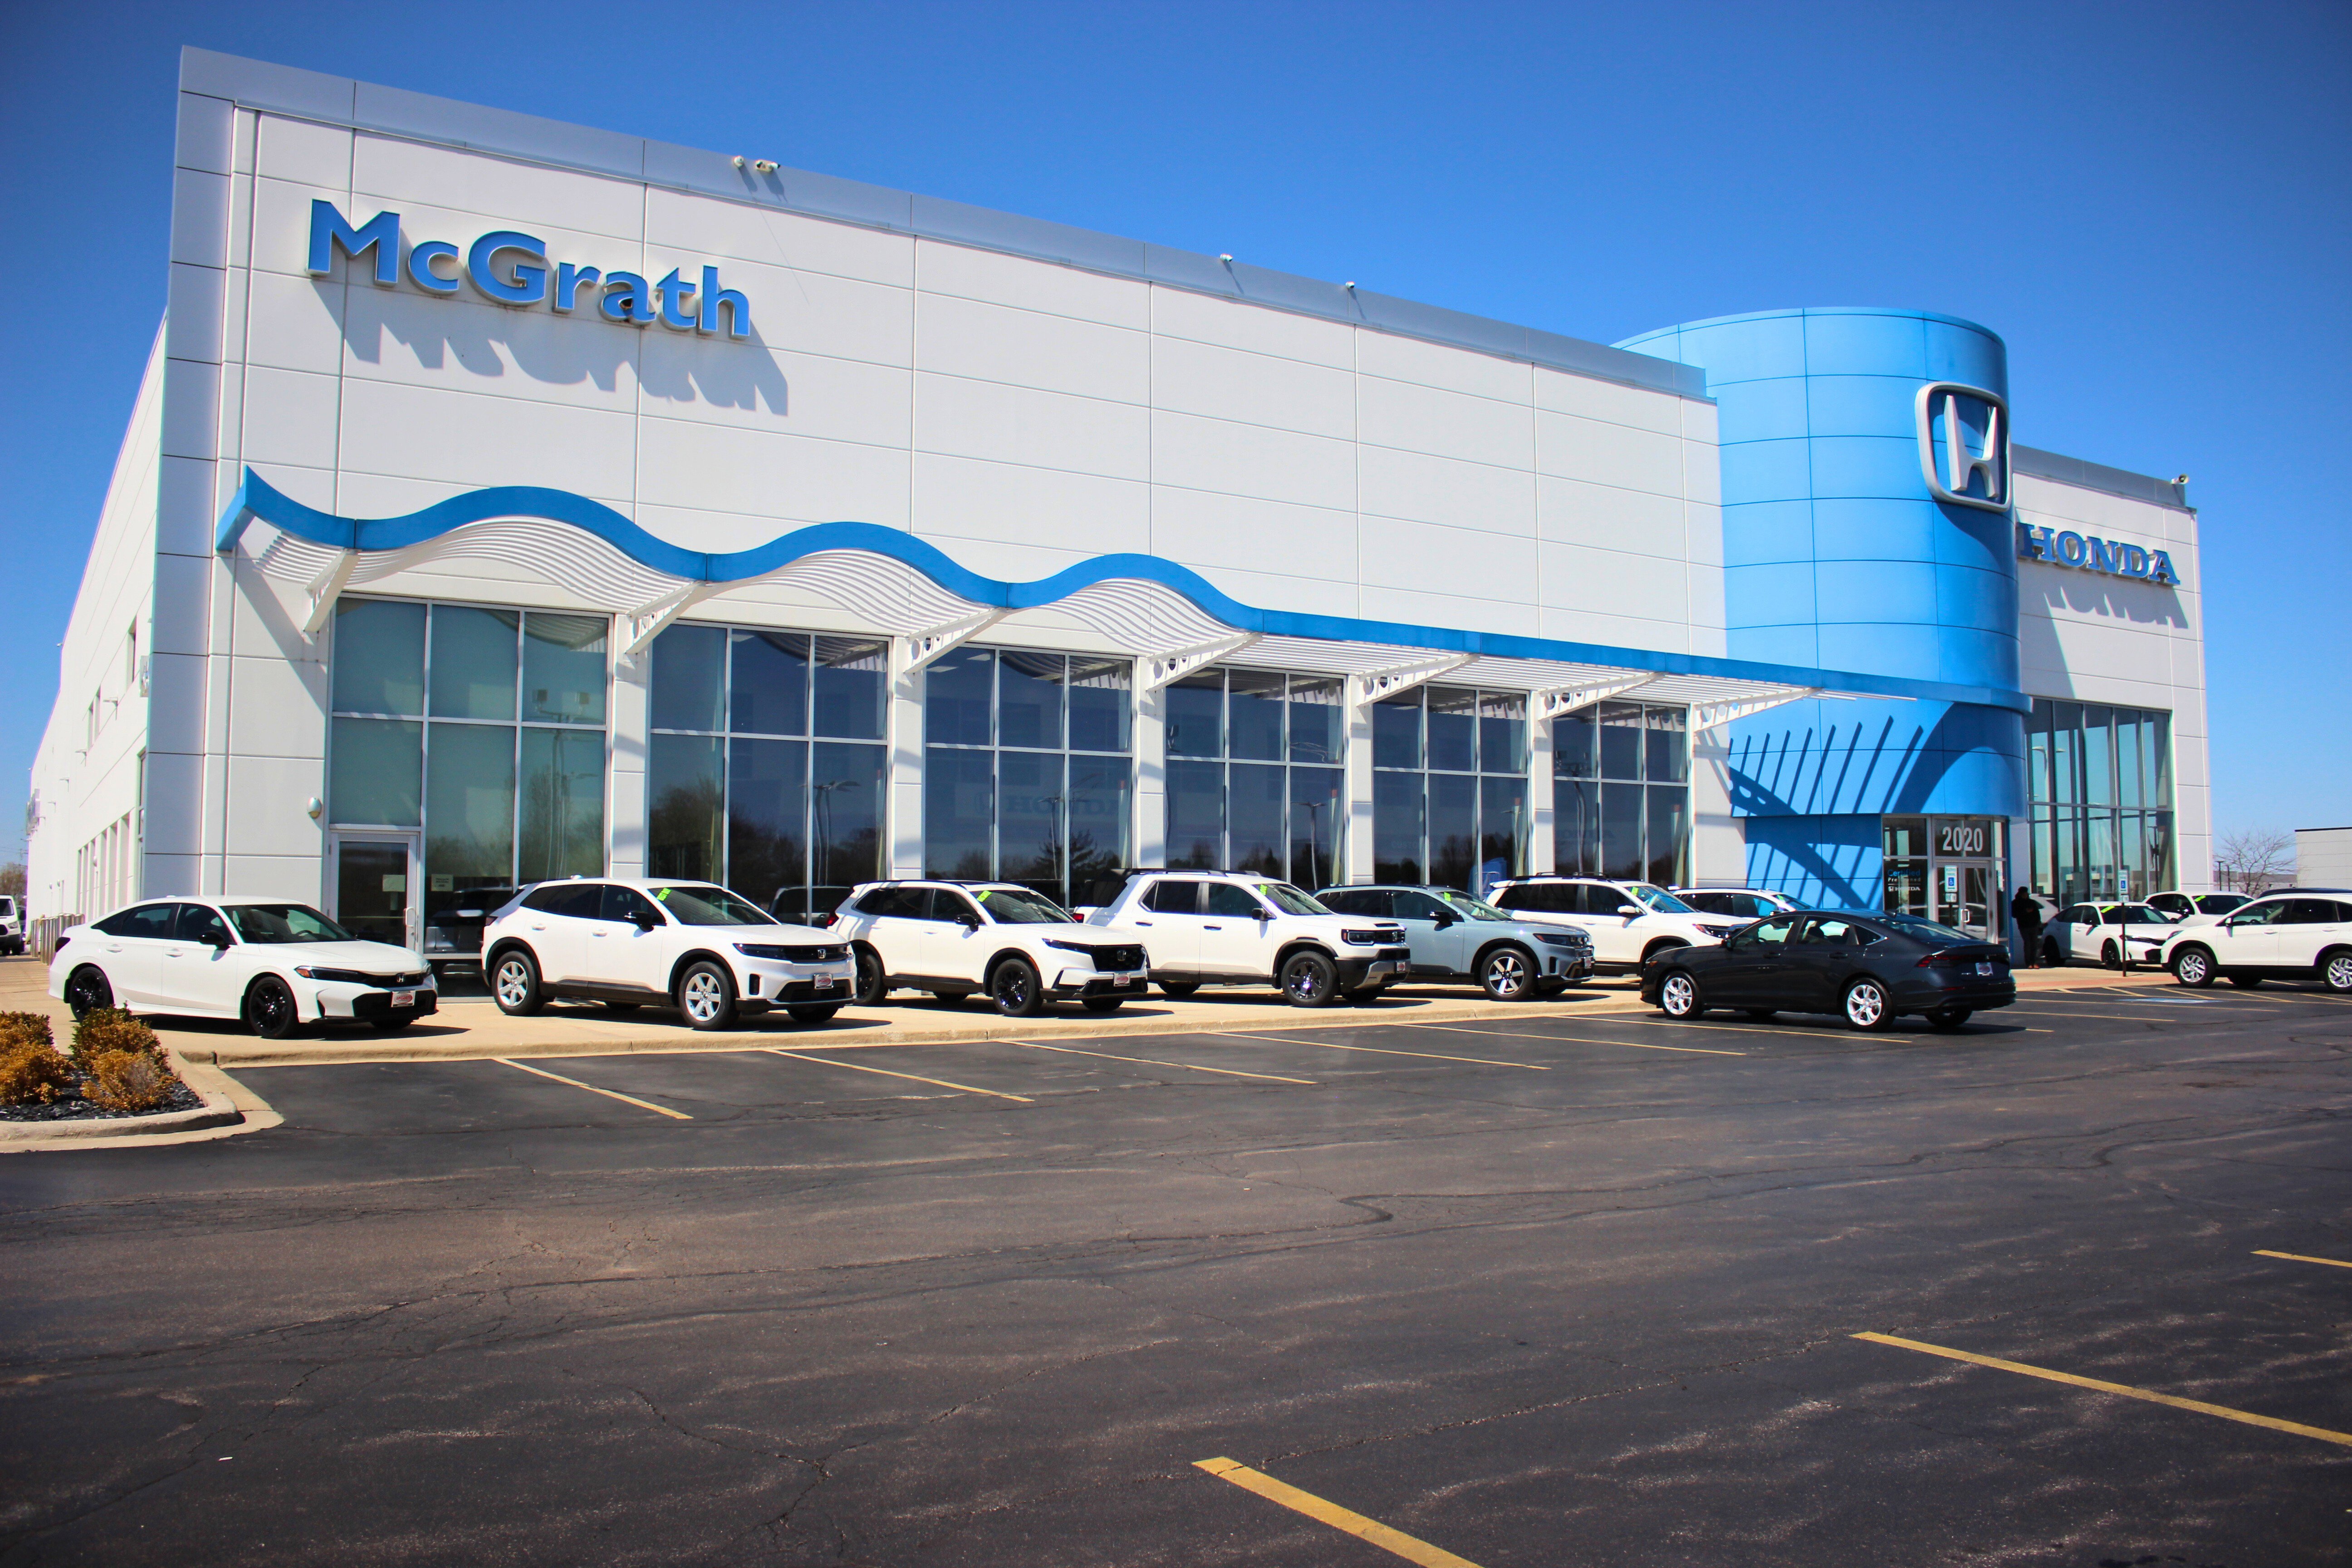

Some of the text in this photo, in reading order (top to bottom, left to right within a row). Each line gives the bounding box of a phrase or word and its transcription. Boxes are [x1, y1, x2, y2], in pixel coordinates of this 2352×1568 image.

[305, 198, 750, 339] McGrath
[2017, 522, 2181, 586] HONDA
[1942, 826, 1983, 852] 2020
